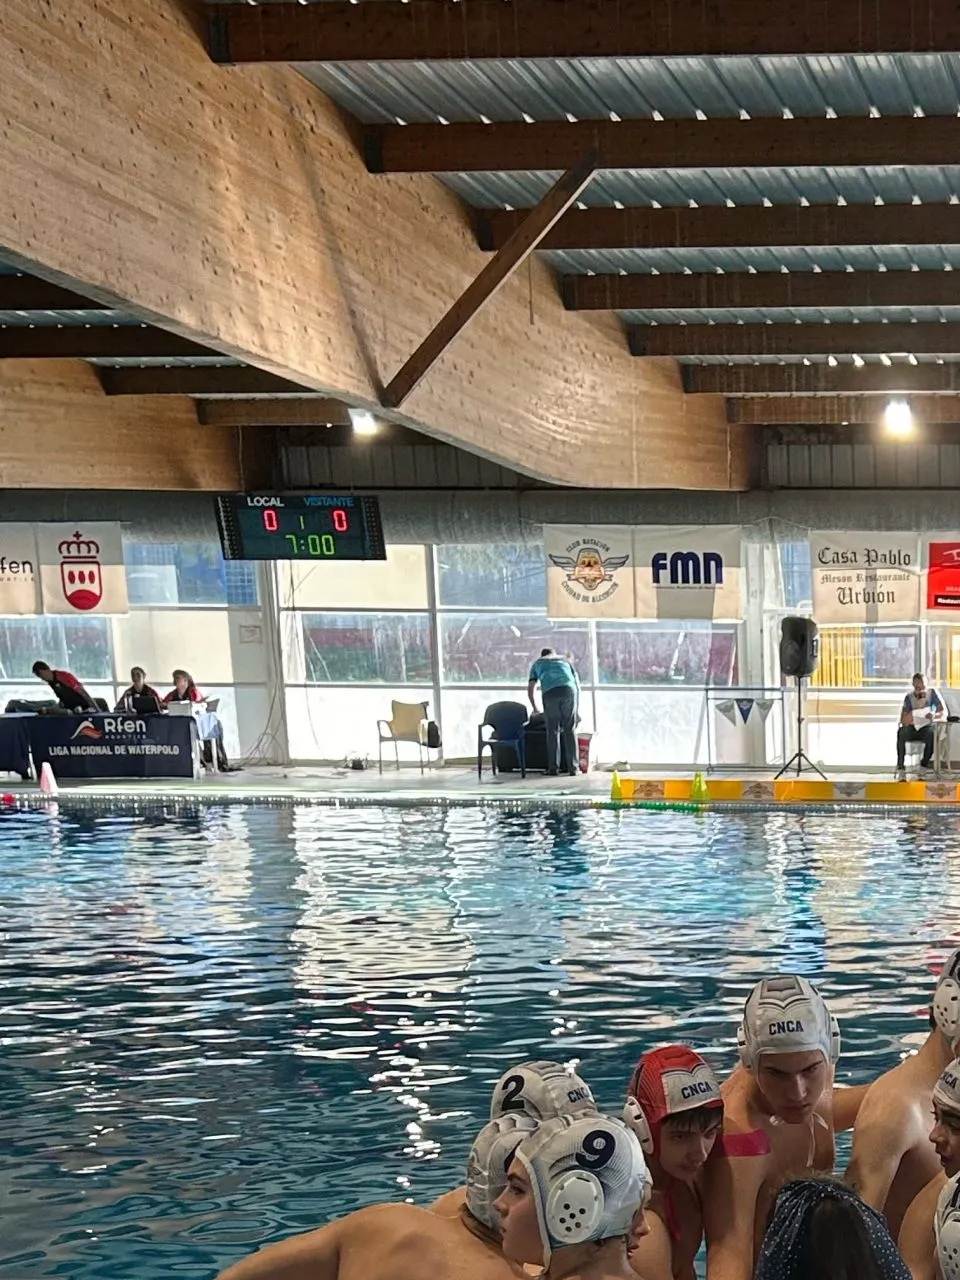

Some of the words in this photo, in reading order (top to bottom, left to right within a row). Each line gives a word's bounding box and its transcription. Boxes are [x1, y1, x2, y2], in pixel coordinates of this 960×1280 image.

[247, 496, 285, 507] LOCAL
[303, 497, 355, 507] VISITANTE
[263, 509, 277, 531] 0
[332, 509, 347, 531] 0
[285, 534, 335, 555] 7:00
[817, 547, 858, 565] Casa
[863, 547, 912, 567] Pablo
[836, 583, 896, 605] Urbión
[103, 717, 147, 733] Rfen
[48, 746, 70, 756] LIGA
[70, 745, 113, 755] NACIONAL
[114, 745, 127, 754] DE
[128, 744, 180, 755] WATERPOLO
[768, 1020, 804, 1036] CNCA
[501, 1074, 525, 1112] 2
[567, 1086, 591, 1103] CNC
[681, 1081, 713, 1100] CNCA
[574, 1129, 617, 1170] 9
